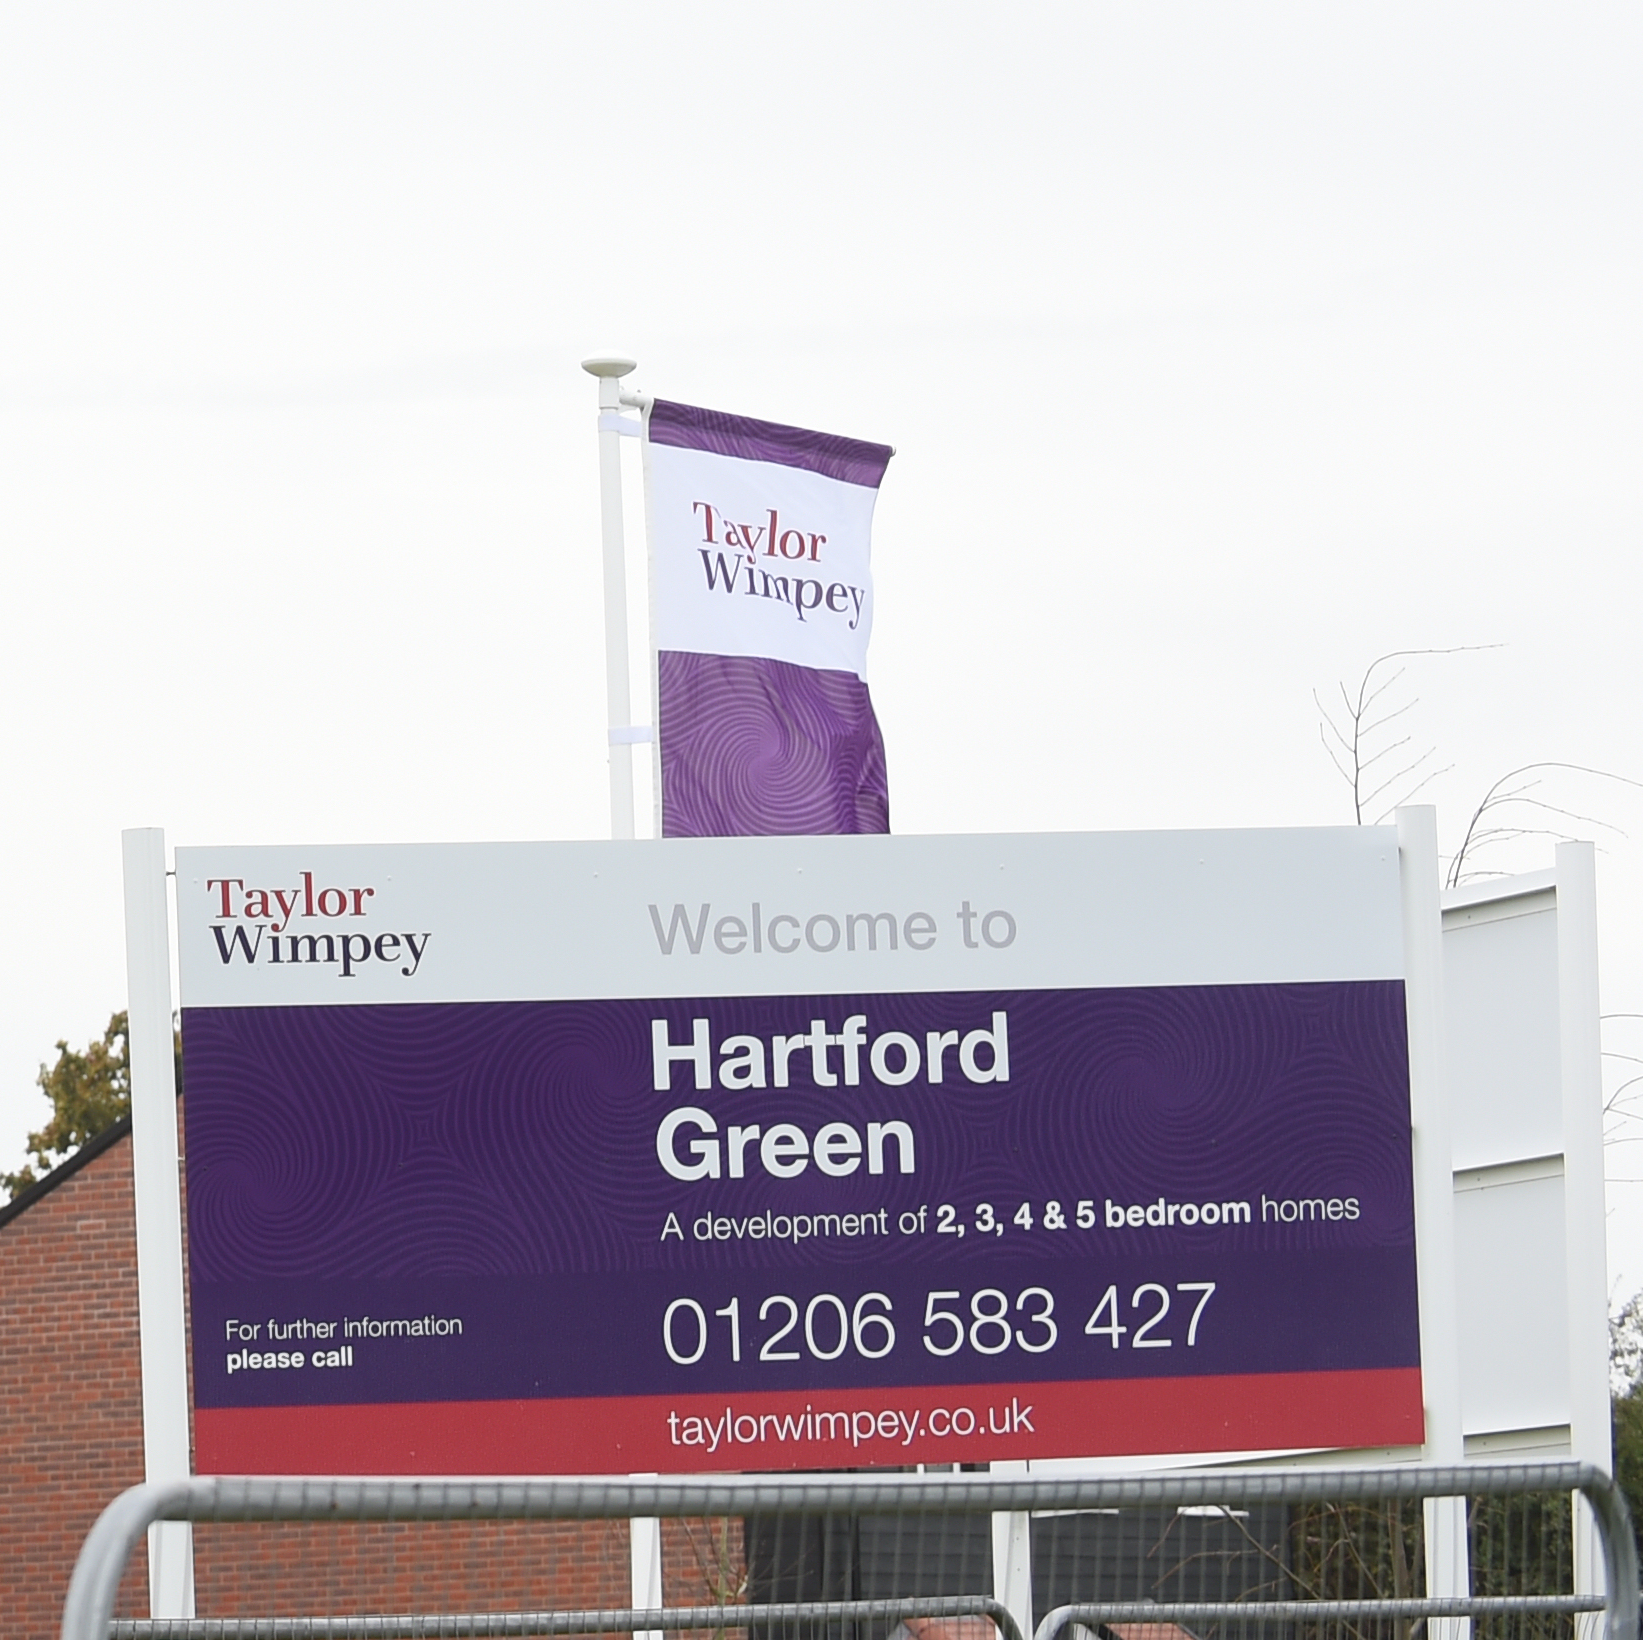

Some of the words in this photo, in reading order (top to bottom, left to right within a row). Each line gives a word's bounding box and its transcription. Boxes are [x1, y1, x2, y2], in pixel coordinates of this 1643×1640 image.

[693, 501, 827, 565] Taylor
[698, 548, 865, 630] Wimpey
[207, 871, 375, 933] Taylor
[648, 902, 937, 955] Welcome
[956, 900, 1018, 949] to
[209, 924, 432, 977] Wimpey
[651, 1011, 1010, 1091] Hartford
[656, 1106, 915, 1181] Green
[660, 1211, 685, 1242] A
[693, 1207, 889, 1245] development
[898, 1204, 928, 1235] of
[936, 1204, 965, 1239] 2,
[975, 1202, 1004, 1237] 3,
[1013, 1202, 1034, 1231] 4
[1042, 1200, 1068, 1230] &
[1075, 1200, 1096, 1229] 5
[1104, 1197, 1252, 1228] bedroom
[1261, 1194, 1361, 1223] homes
[225, 1319, 262, 1341] For
[266, 1317, 338, 1340] further
[343, 1314, 463, 1338] information
[663, 1292, 896, 1365] 01206
[922, 1286, 1058, 1357] 583
[1084, 1282, 1217, 1349] 427
[226, 1348, 305, 1375] please
[311, 1345, 353, 1368] call
[666, 1397, 1035, 1450] taylorwimpey.co.uk
